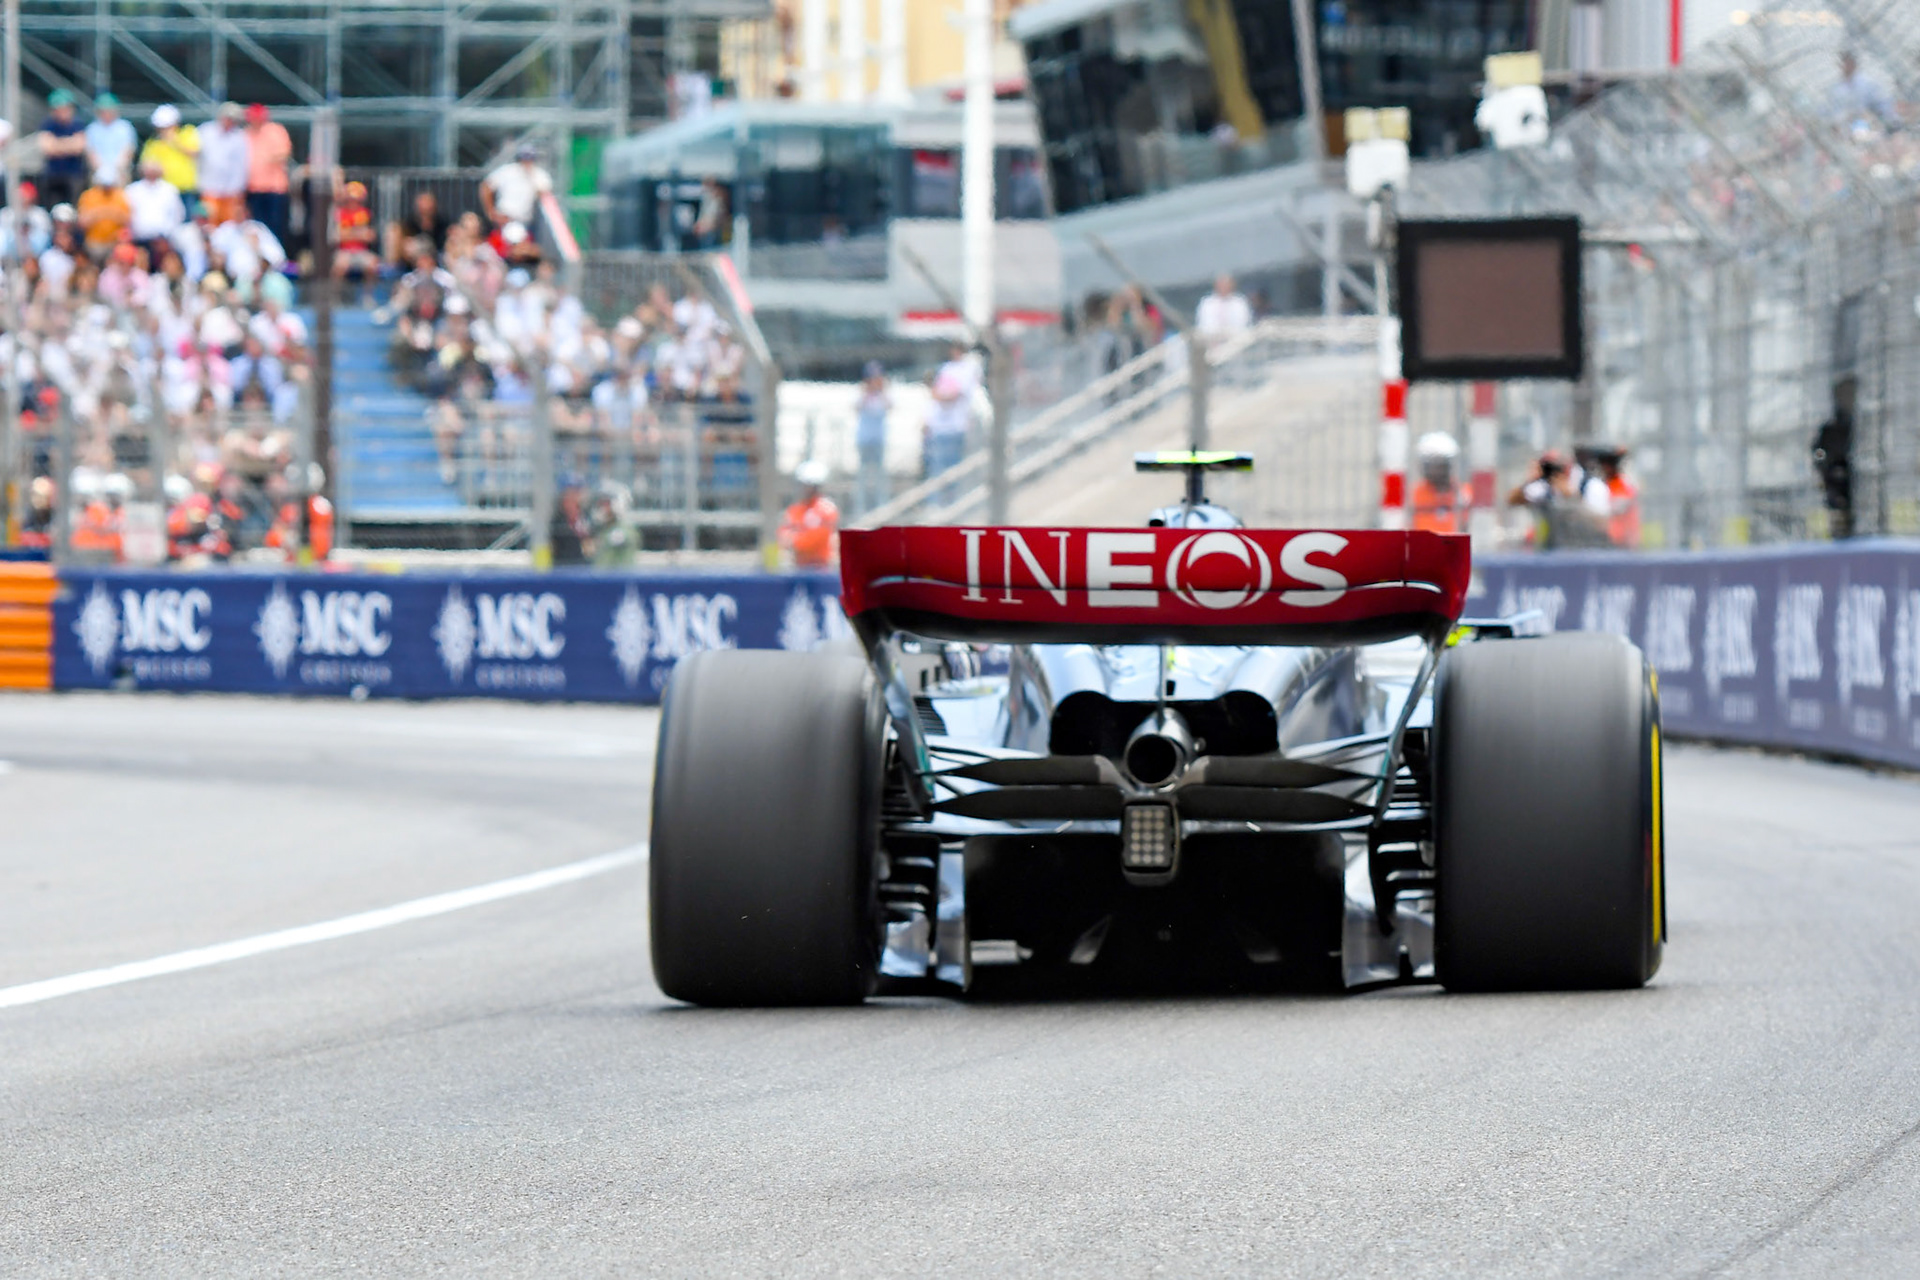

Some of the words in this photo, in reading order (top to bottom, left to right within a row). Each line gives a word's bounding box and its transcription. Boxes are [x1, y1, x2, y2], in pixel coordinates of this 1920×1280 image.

[959, 529, 1350, 610] INEOS
[120, 587, 212, 653] MSC
[301, 589, 393, 657] MSC
[476, 592, 567, 660] MSC
[651, 592, 738, 660] MSC
